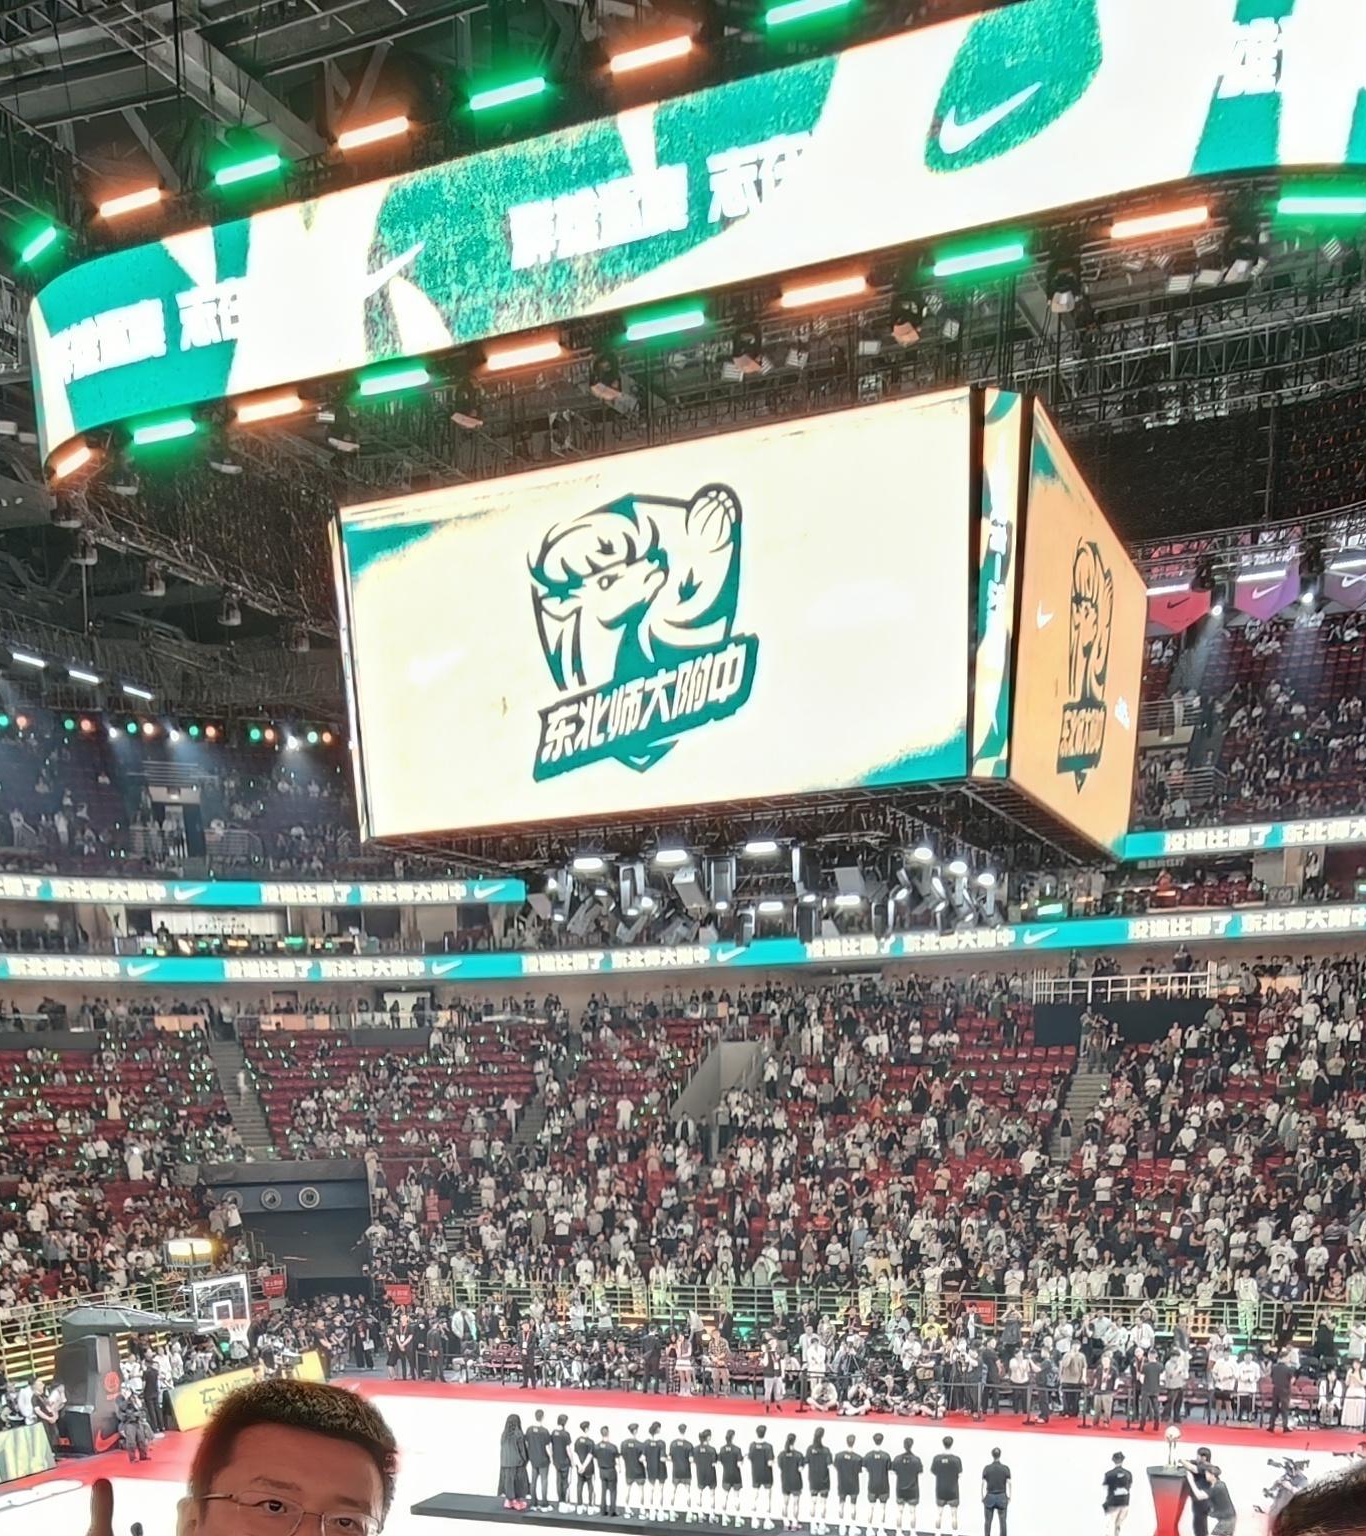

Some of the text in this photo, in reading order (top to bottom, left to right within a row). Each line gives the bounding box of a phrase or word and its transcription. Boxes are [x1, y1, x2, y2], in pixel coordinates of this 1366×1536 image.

[541, 643, 746, 764] 东北师大附中
[1164, 826, 1273, 852] 没谁比得了
[1129, 916, 1232, 939] 没谁比得了
